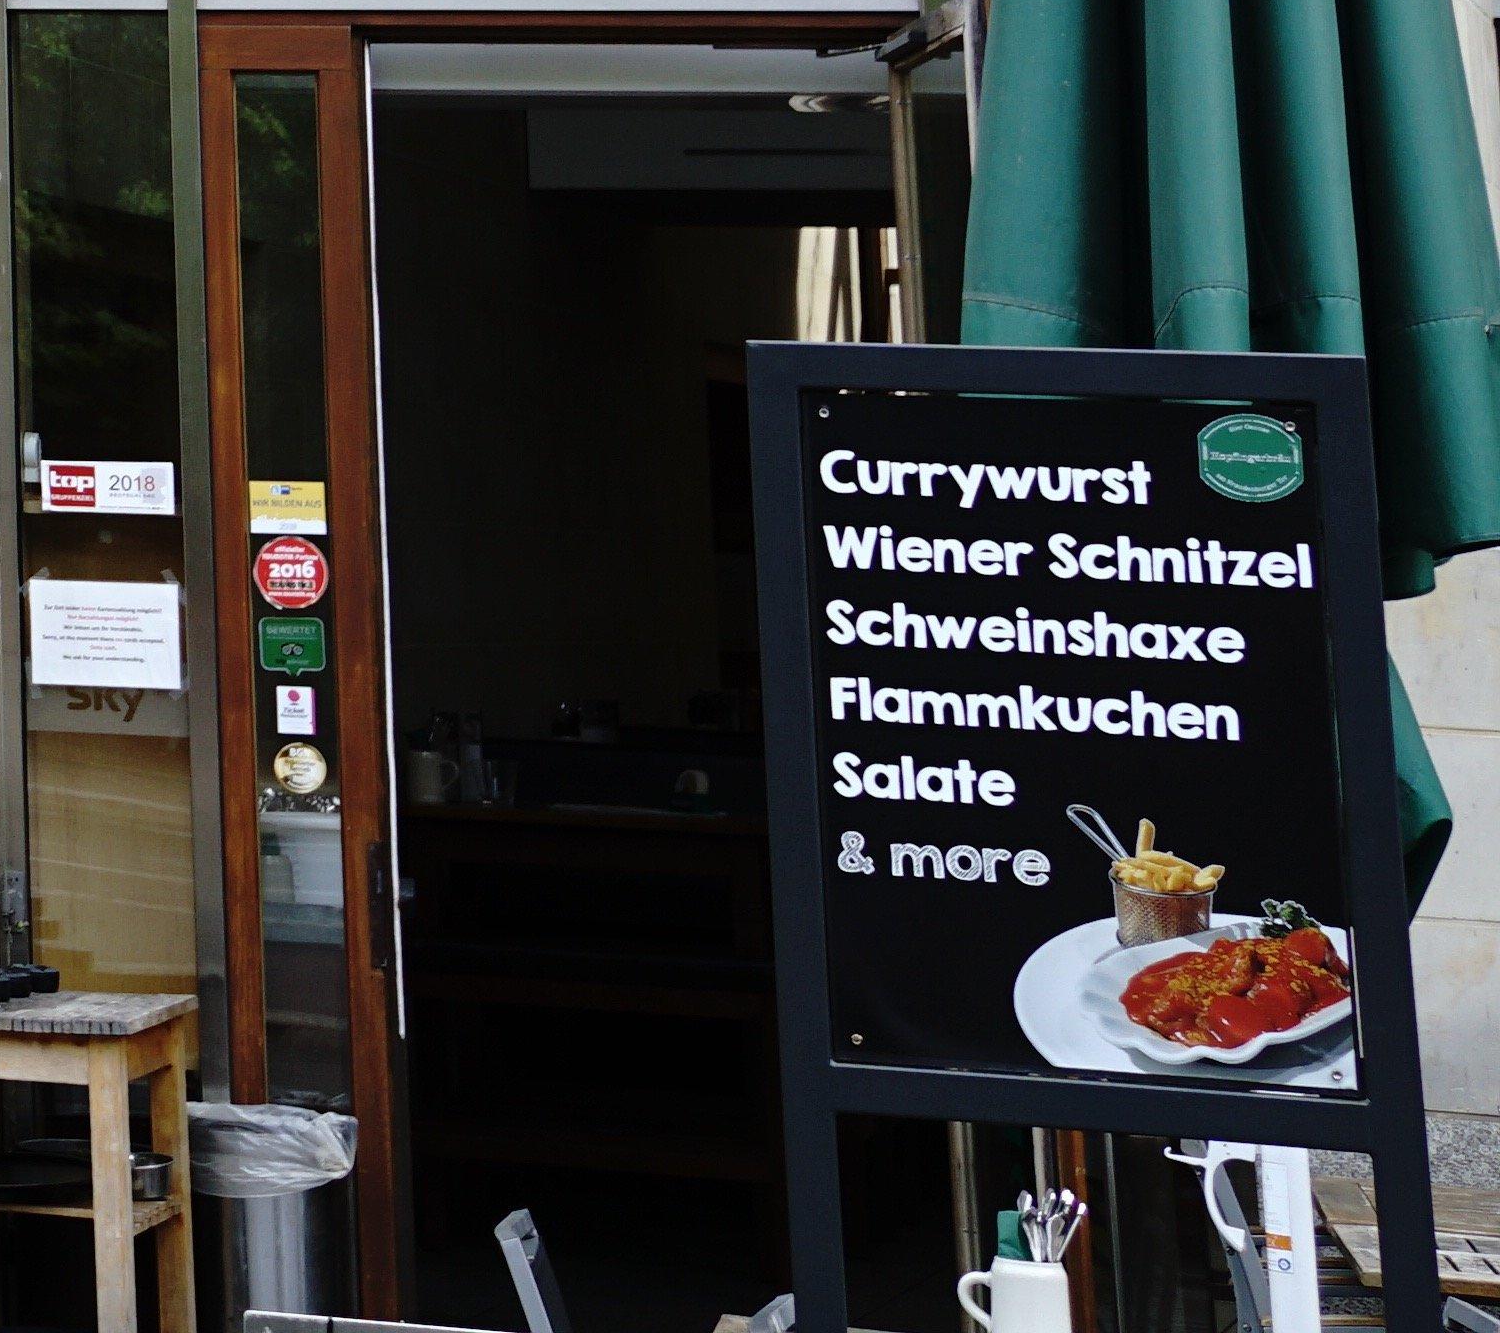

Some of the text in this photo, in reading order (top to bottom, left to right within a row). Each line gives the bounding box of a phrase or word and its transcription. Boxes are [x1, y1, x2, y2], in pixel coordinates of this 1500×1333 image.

[50, 470, 95, 492] top
[109, 474, 155, 492] 2018
[819, 449, 1152, 508] Currywurst
[268, 561, 316, 578] 2016
[822, 525, 1313, 589] Wiener Schnitzel
[825, 600, 1246, 664] Schweinshaxe
[829, 677, 1240, 741] Flammkuchen
[832, 751, 1016, 807] Salate
[837, 830, 1051, 886] & more
